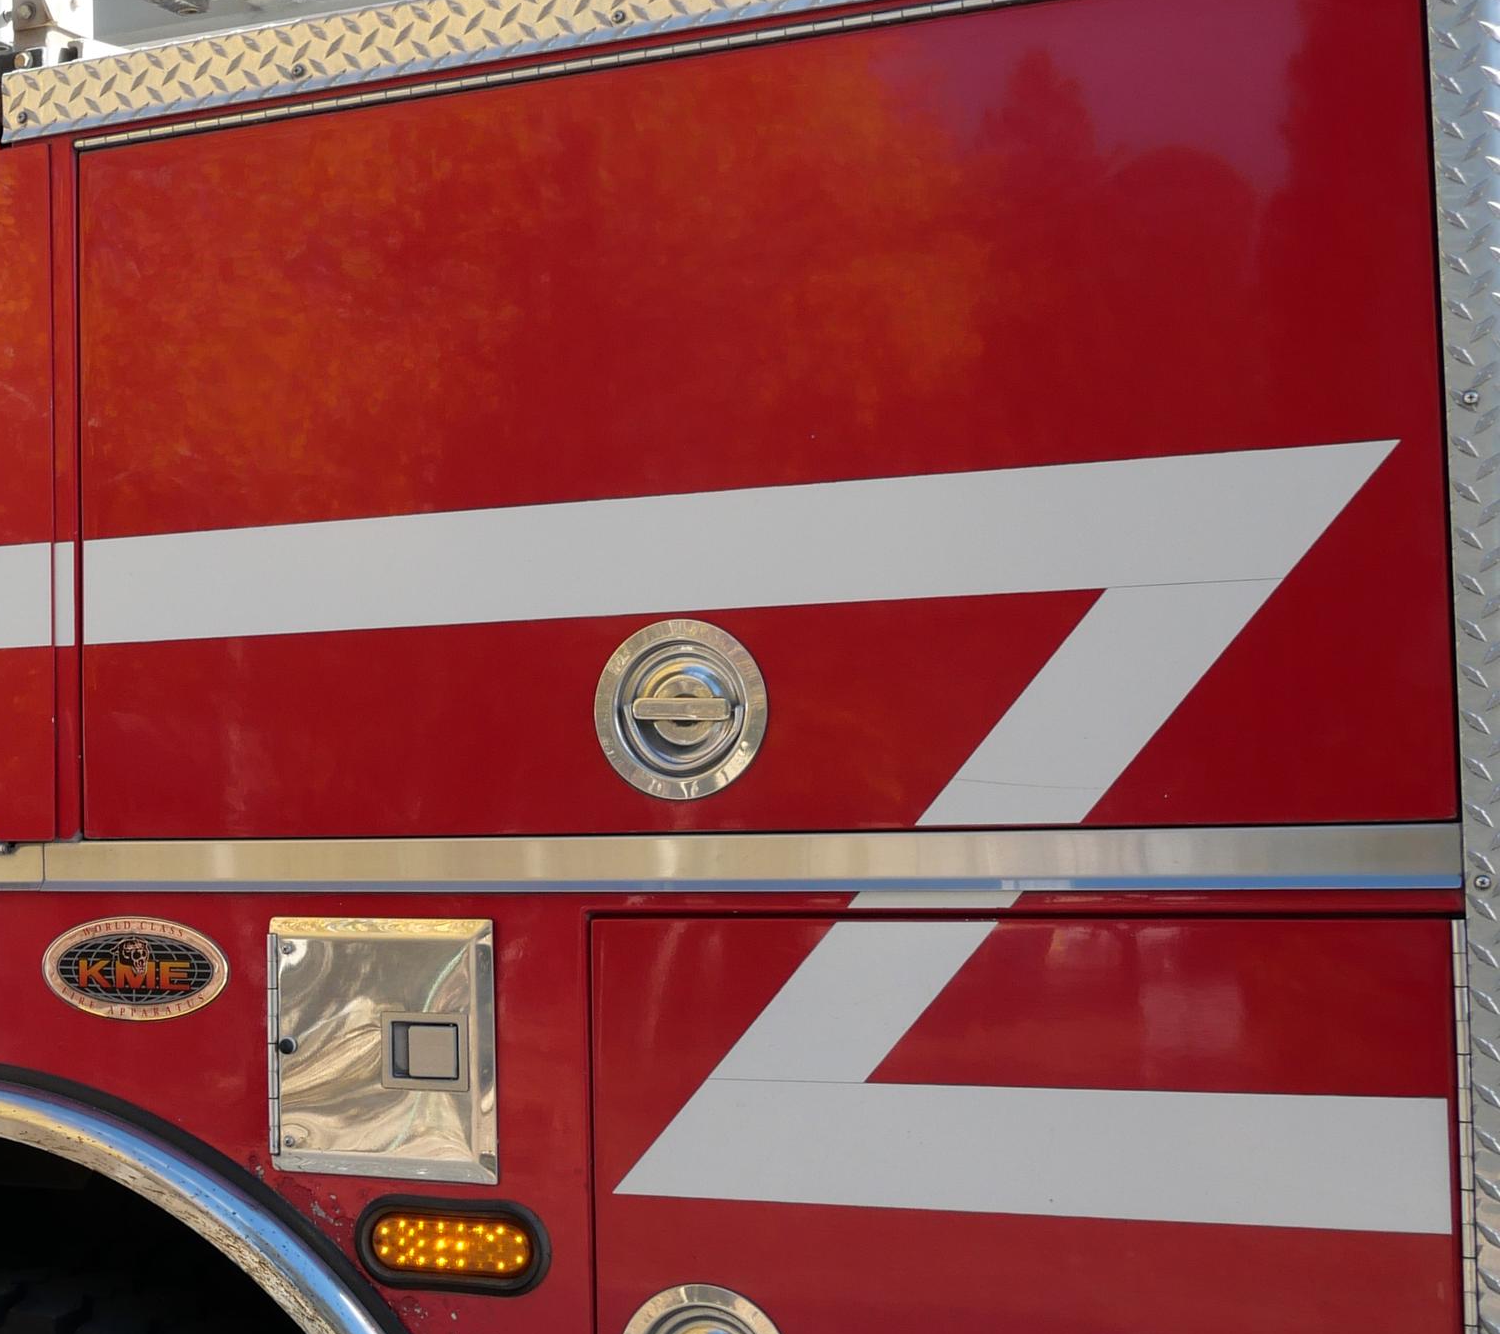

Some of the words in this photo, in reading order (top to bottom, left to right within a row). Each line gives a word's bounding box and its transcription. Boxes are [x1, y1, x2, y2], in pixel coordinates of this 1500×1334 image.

[83, 920, 131, 936] WORLD
[139, 921, 185, 937] CLASS
[78, 959, 192, 990] KME
[62, 987, 95, 1009] FIRE
[107, 993, 206, 1018] APPARATUS
